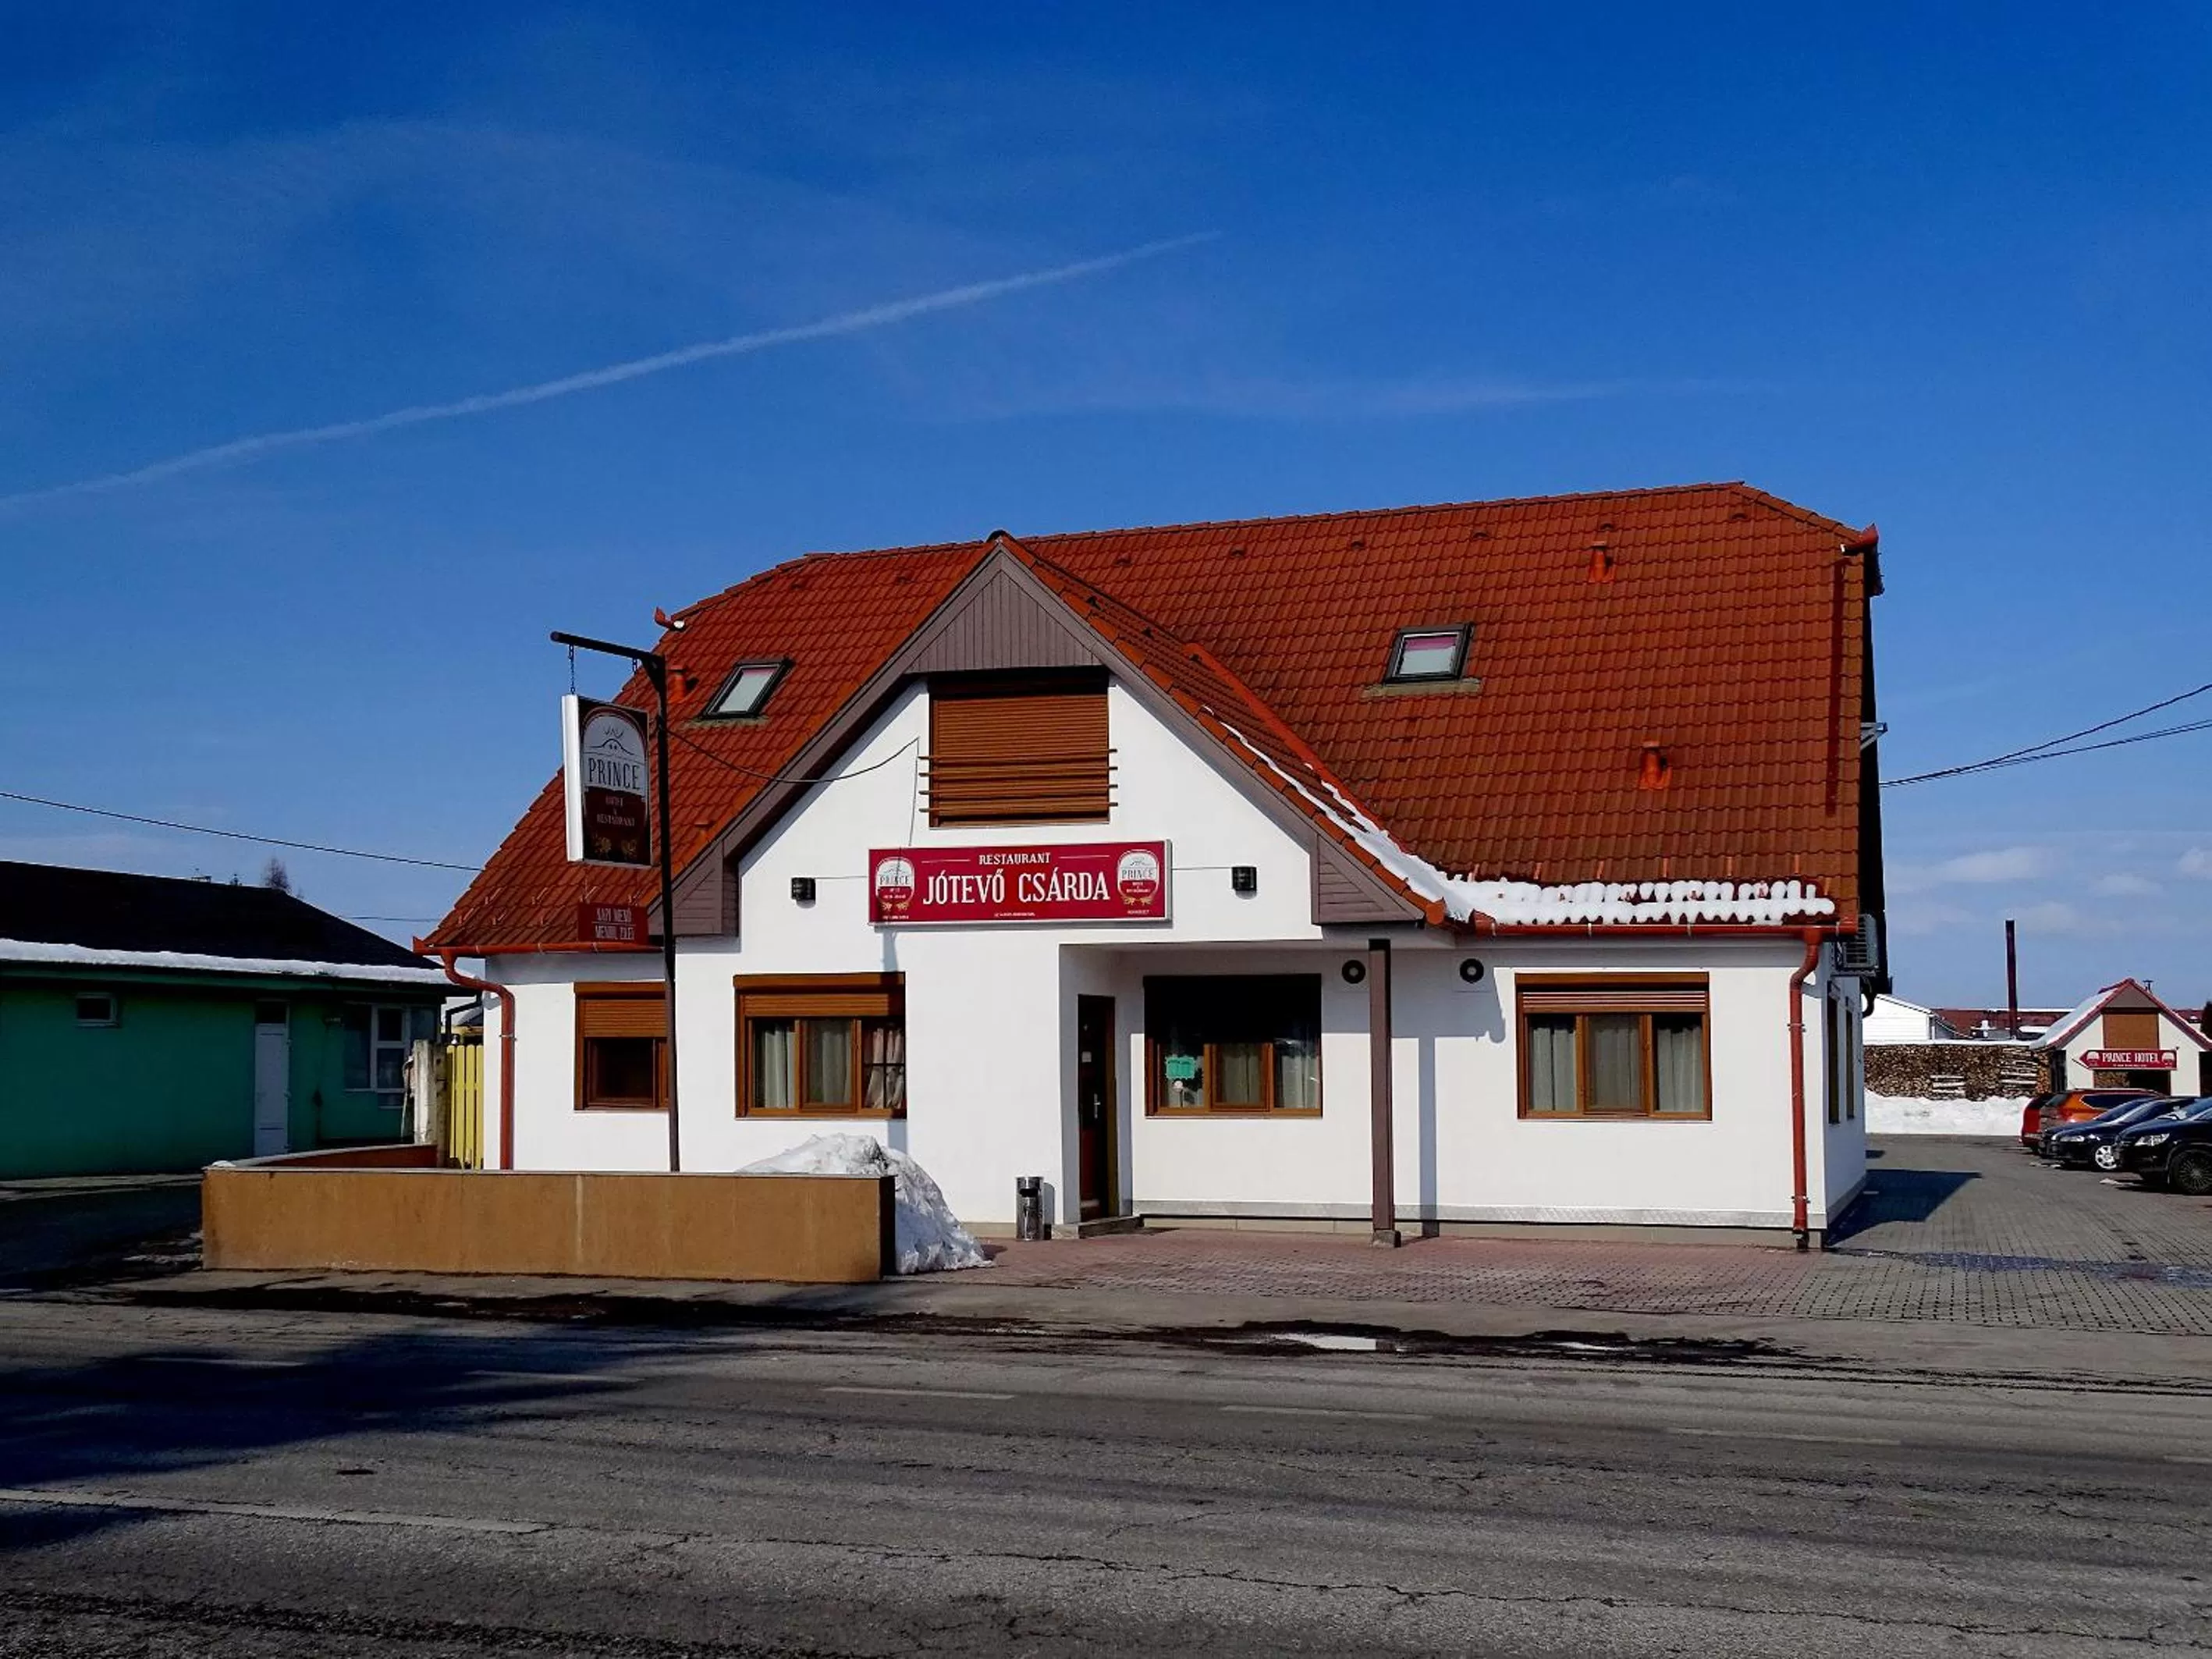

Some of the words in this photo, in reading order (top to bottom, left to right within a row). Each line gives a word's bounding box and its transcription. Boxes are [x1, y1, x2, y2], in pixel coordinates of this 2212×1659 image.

[588, 757, 641, 790] PRINCE
[978, 852, 1051, 865] RESTAURANT
[1121, 869, 1153, 879] PRINCE
[922, 868, 1006, 905] JÓTEVŐ
[1017, 866, 1111, 903] CSÁRDA
[2102, 1052, 2132, 1062] PRINCE
[2134, 1052, 2159, 1063] HOTEL
